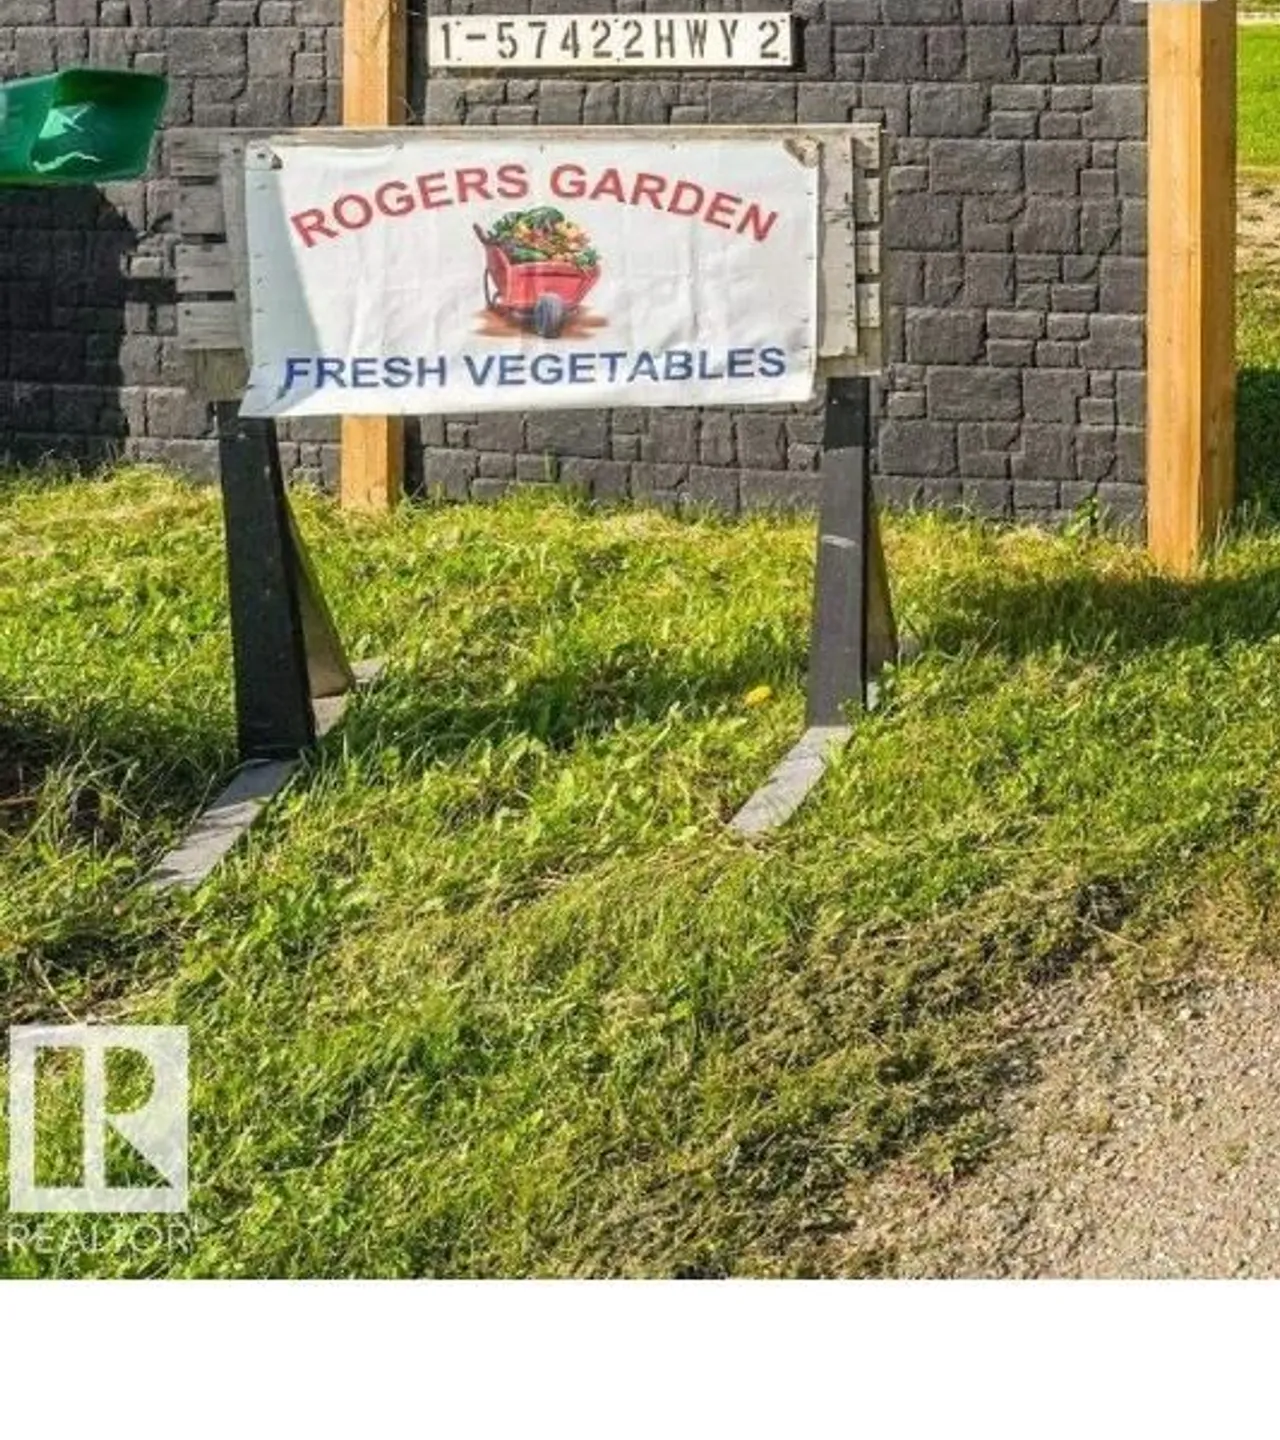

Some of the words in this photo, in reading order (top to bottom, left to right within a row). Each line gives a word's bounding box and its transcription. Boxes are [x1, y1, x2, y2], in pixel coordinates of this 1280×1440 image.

[757, 19, 781, 59] 2
[291, 163, 530, 248] ROGERS
[549, 163, 779, 242] GARDEN
[282, 355, 447, 392] FRESH
[464, 347, 786, 386] VEGETABLES
